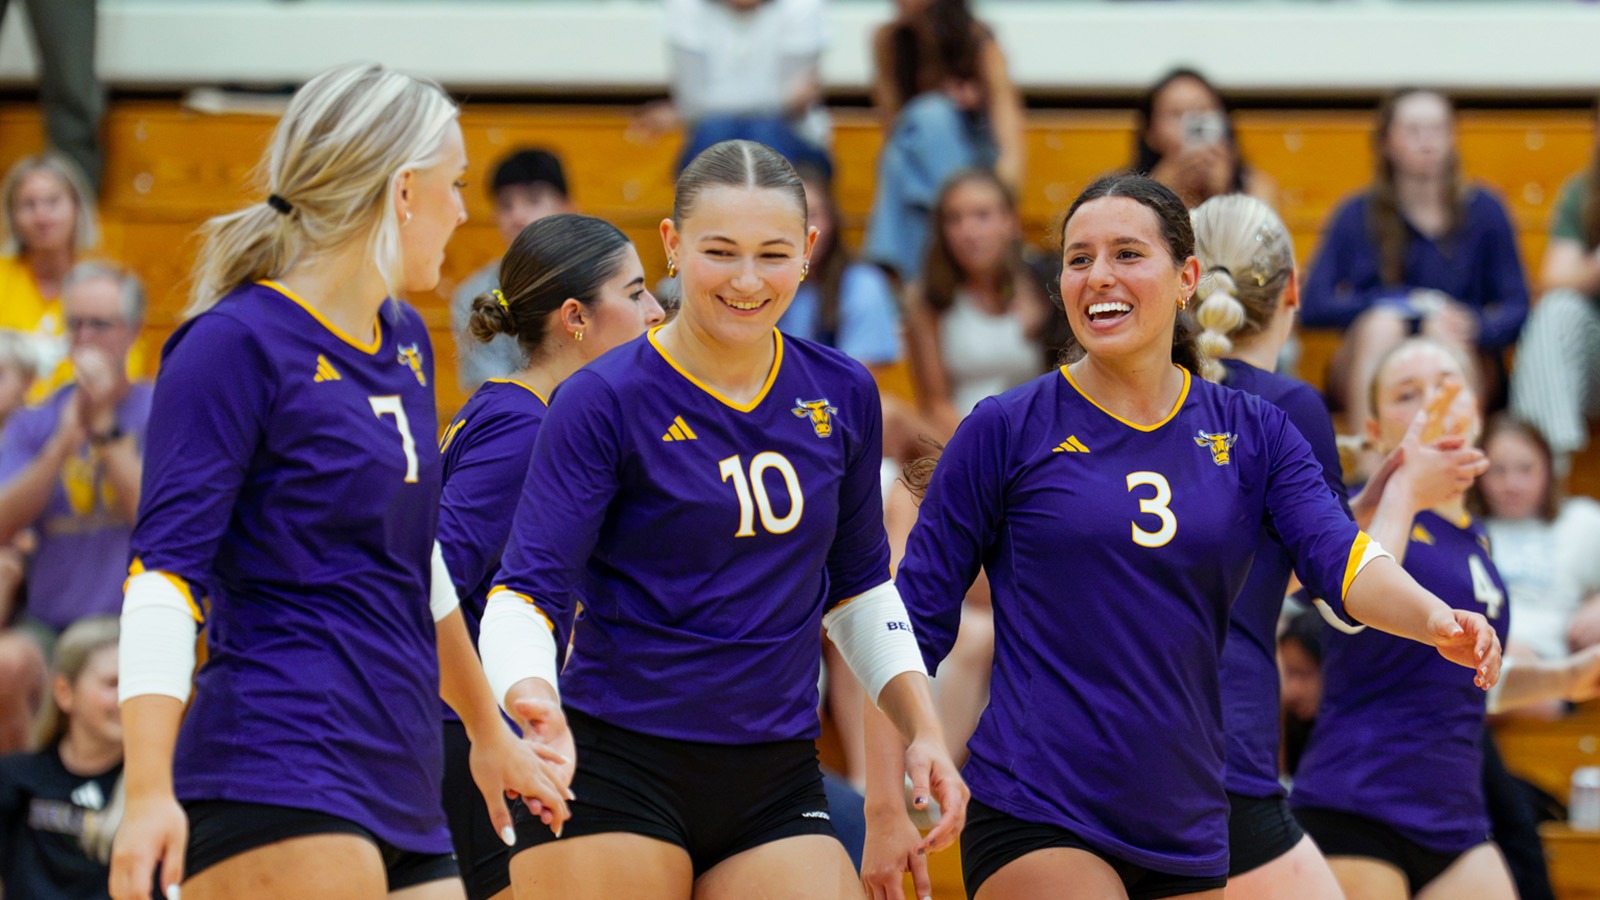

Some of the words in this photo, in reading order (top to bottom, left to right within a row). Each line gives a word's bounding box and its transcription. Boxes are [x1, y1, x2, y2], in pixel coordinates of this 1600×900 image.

[368, 395, 419, 483] 7
[718, 451, 804, 537] 10
[1126, 471, 1177, 548] 3
[1468, 554, 1503, 618] 4
